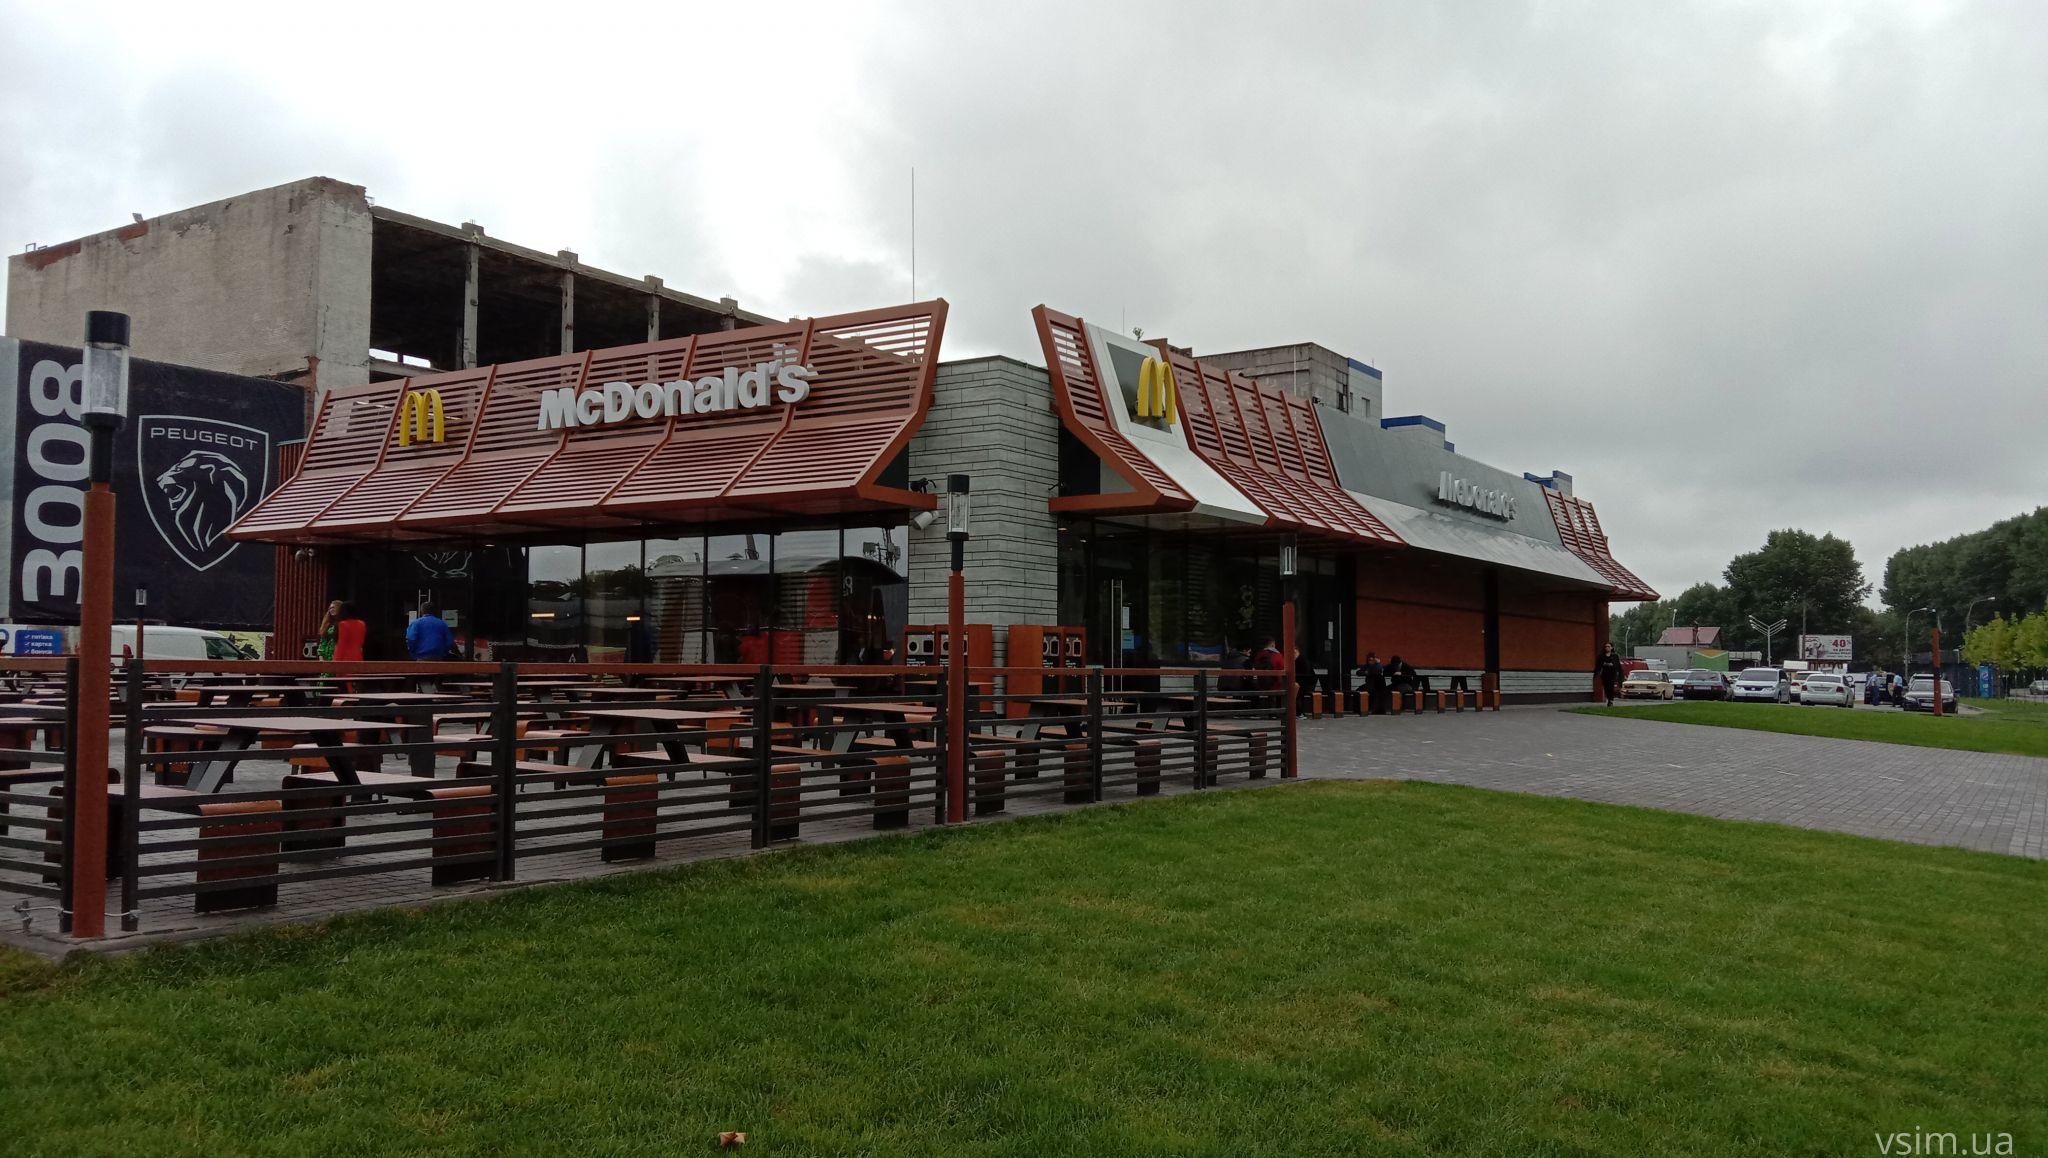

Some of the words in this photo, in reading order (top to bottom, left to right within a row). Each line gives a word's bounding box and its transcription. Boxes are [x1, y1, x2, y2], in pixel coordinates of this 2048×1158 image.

[537, 362, 811, 431] McDonald's
[150, 427, 258, 451] PEUGEOT
[21, 358, 94, 605] 3008
